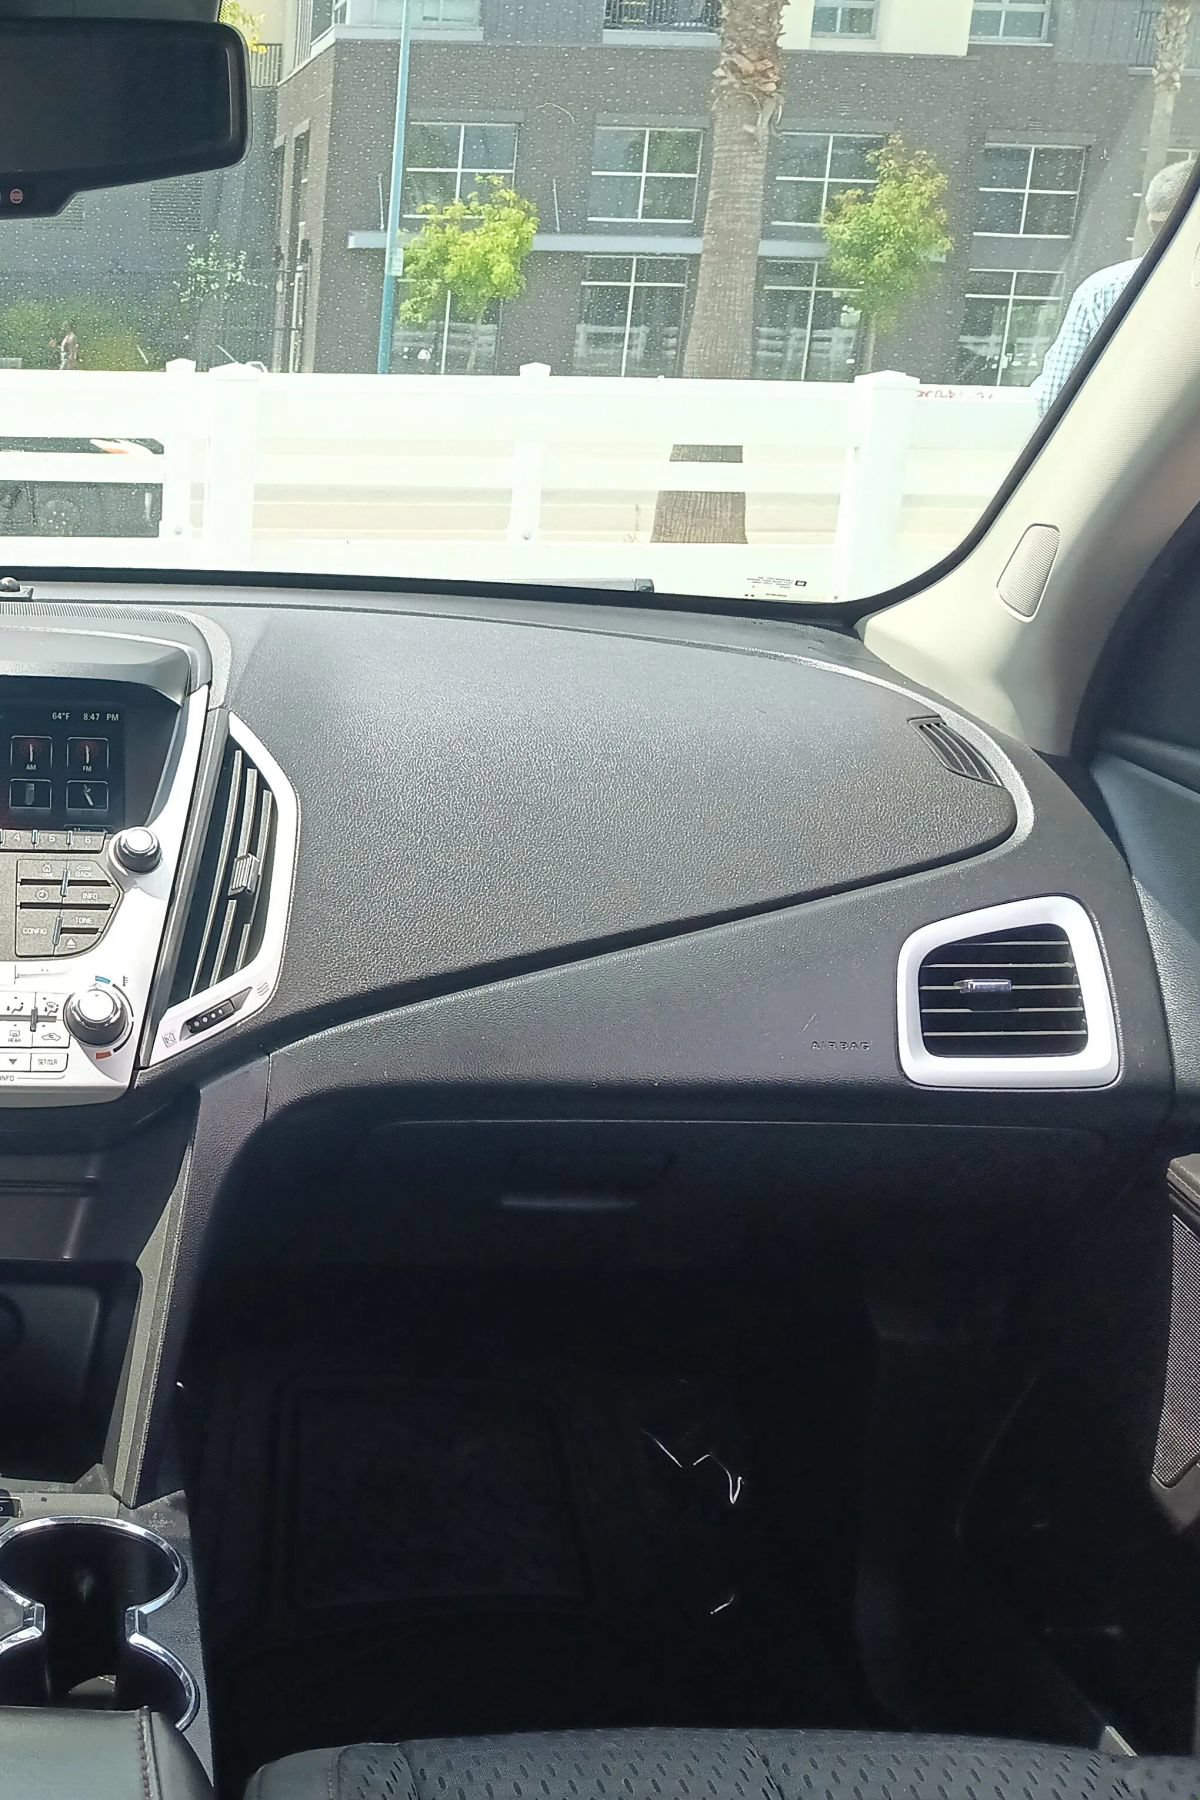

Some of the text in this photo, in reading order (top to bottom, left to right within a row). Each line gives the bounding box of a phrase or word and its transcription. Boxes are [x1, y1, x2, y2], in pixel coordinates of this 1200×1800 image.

[83, 713, 100, 721] 8:47
[106, 713, 119, 721] PM
[49, 834, 56, 842] 5
[82, 892, 98, 900] INFO
[74, 916, 93, 924] TONE
[22, 927, 48, 935] CONFIG
[811, 1041, 870, 1050] AIRBAG
